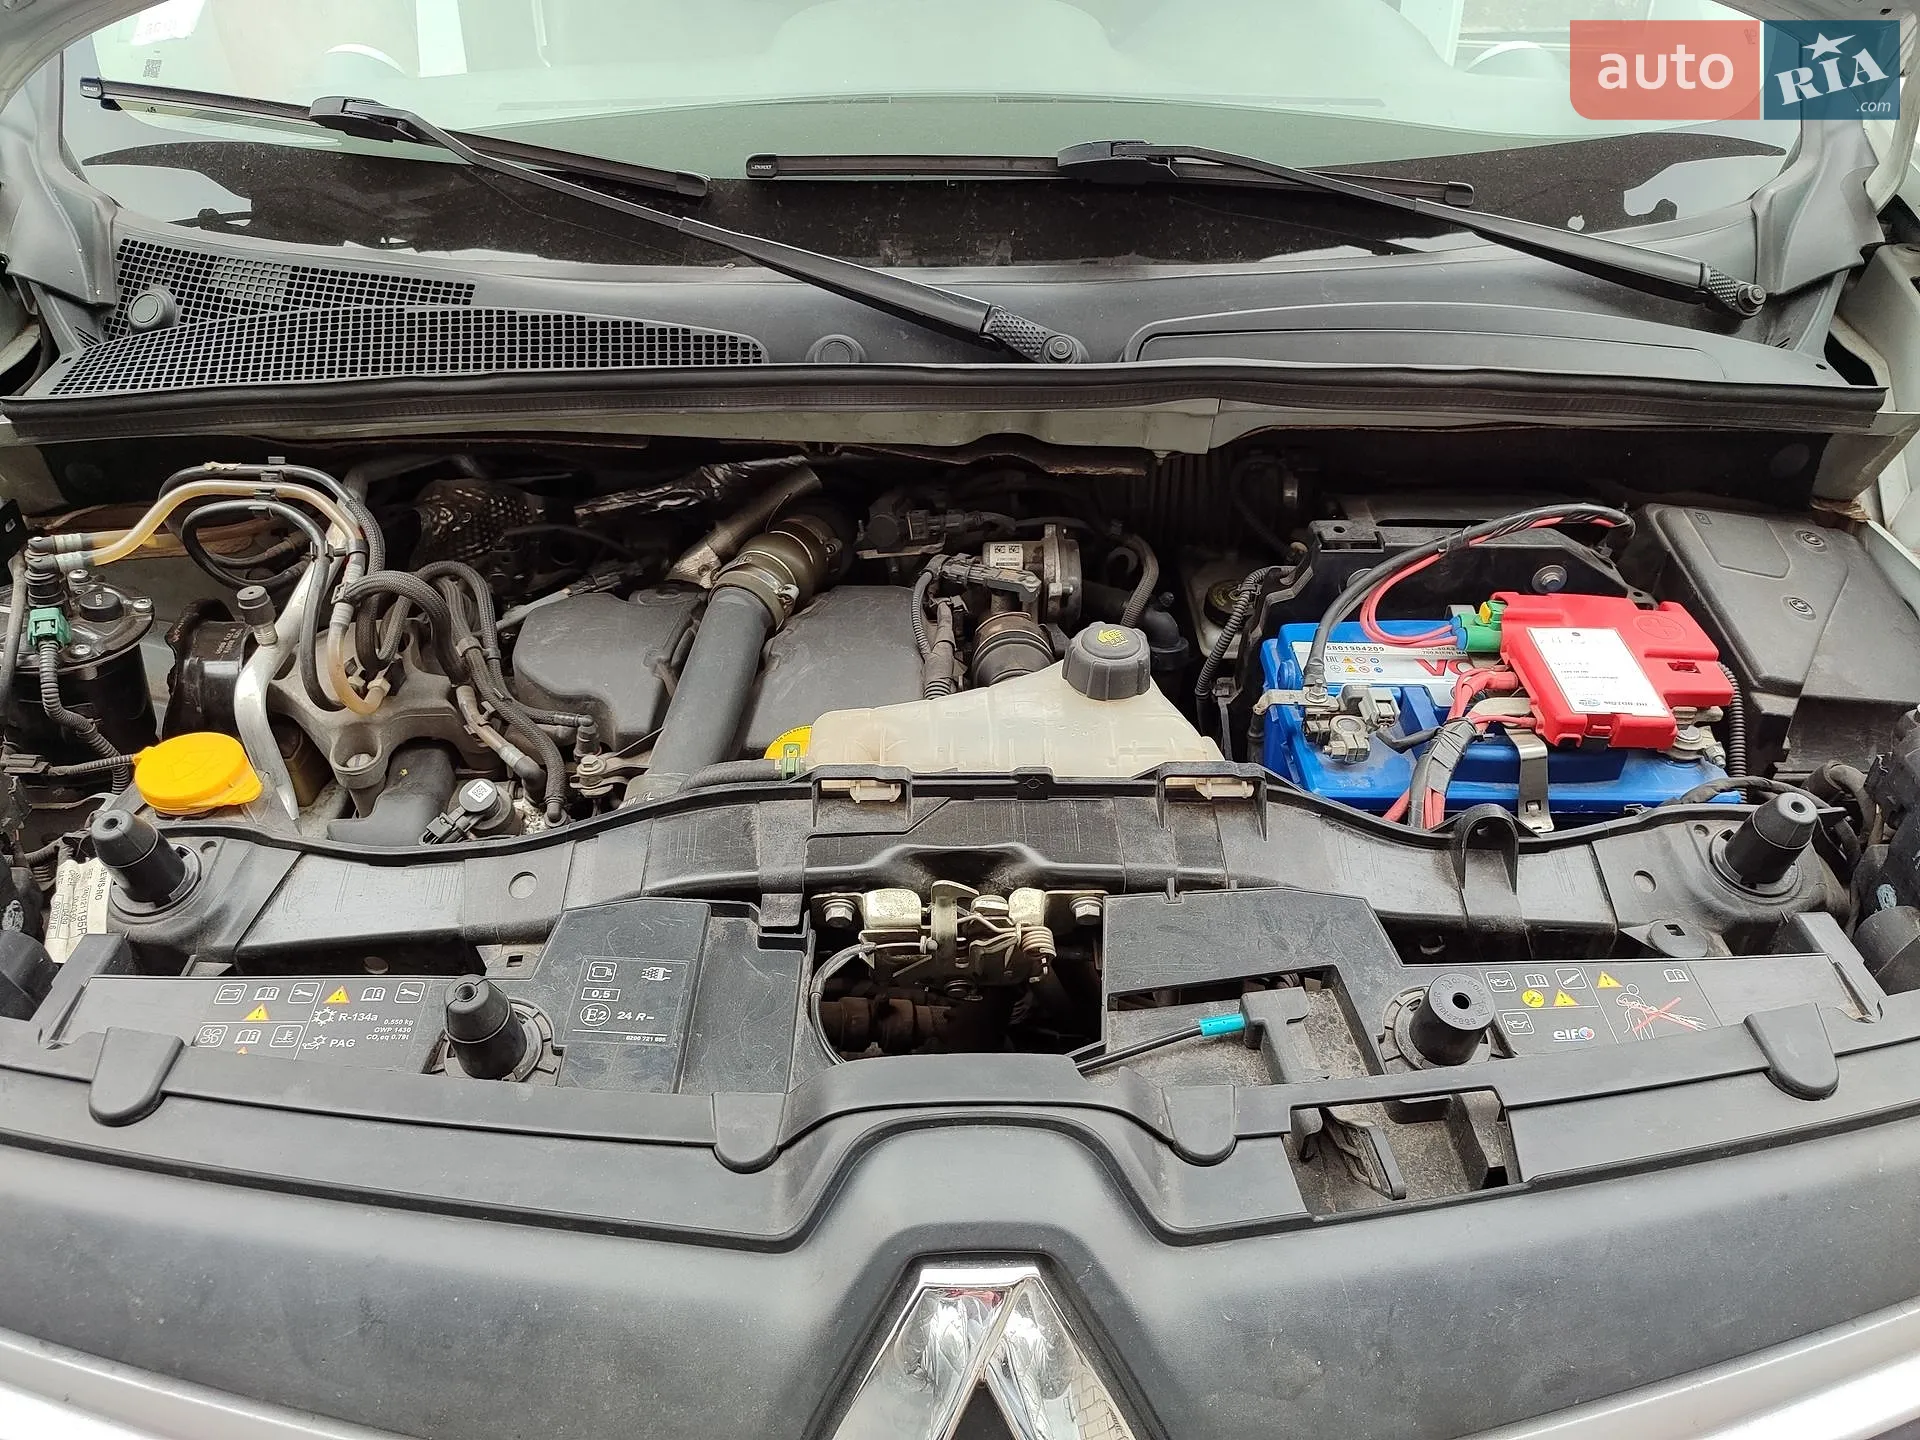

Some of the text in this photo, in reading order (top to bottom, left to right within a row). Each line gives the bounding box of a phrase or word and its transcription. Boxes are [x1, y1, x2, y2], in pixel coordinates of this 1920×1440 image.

[591, 989, 611, 999] 0,5
[338, 1012, 378, 1022] R-134a
[616, 1010, 633, 1021] 24
[329, 1038, 356, 1048] PAG
